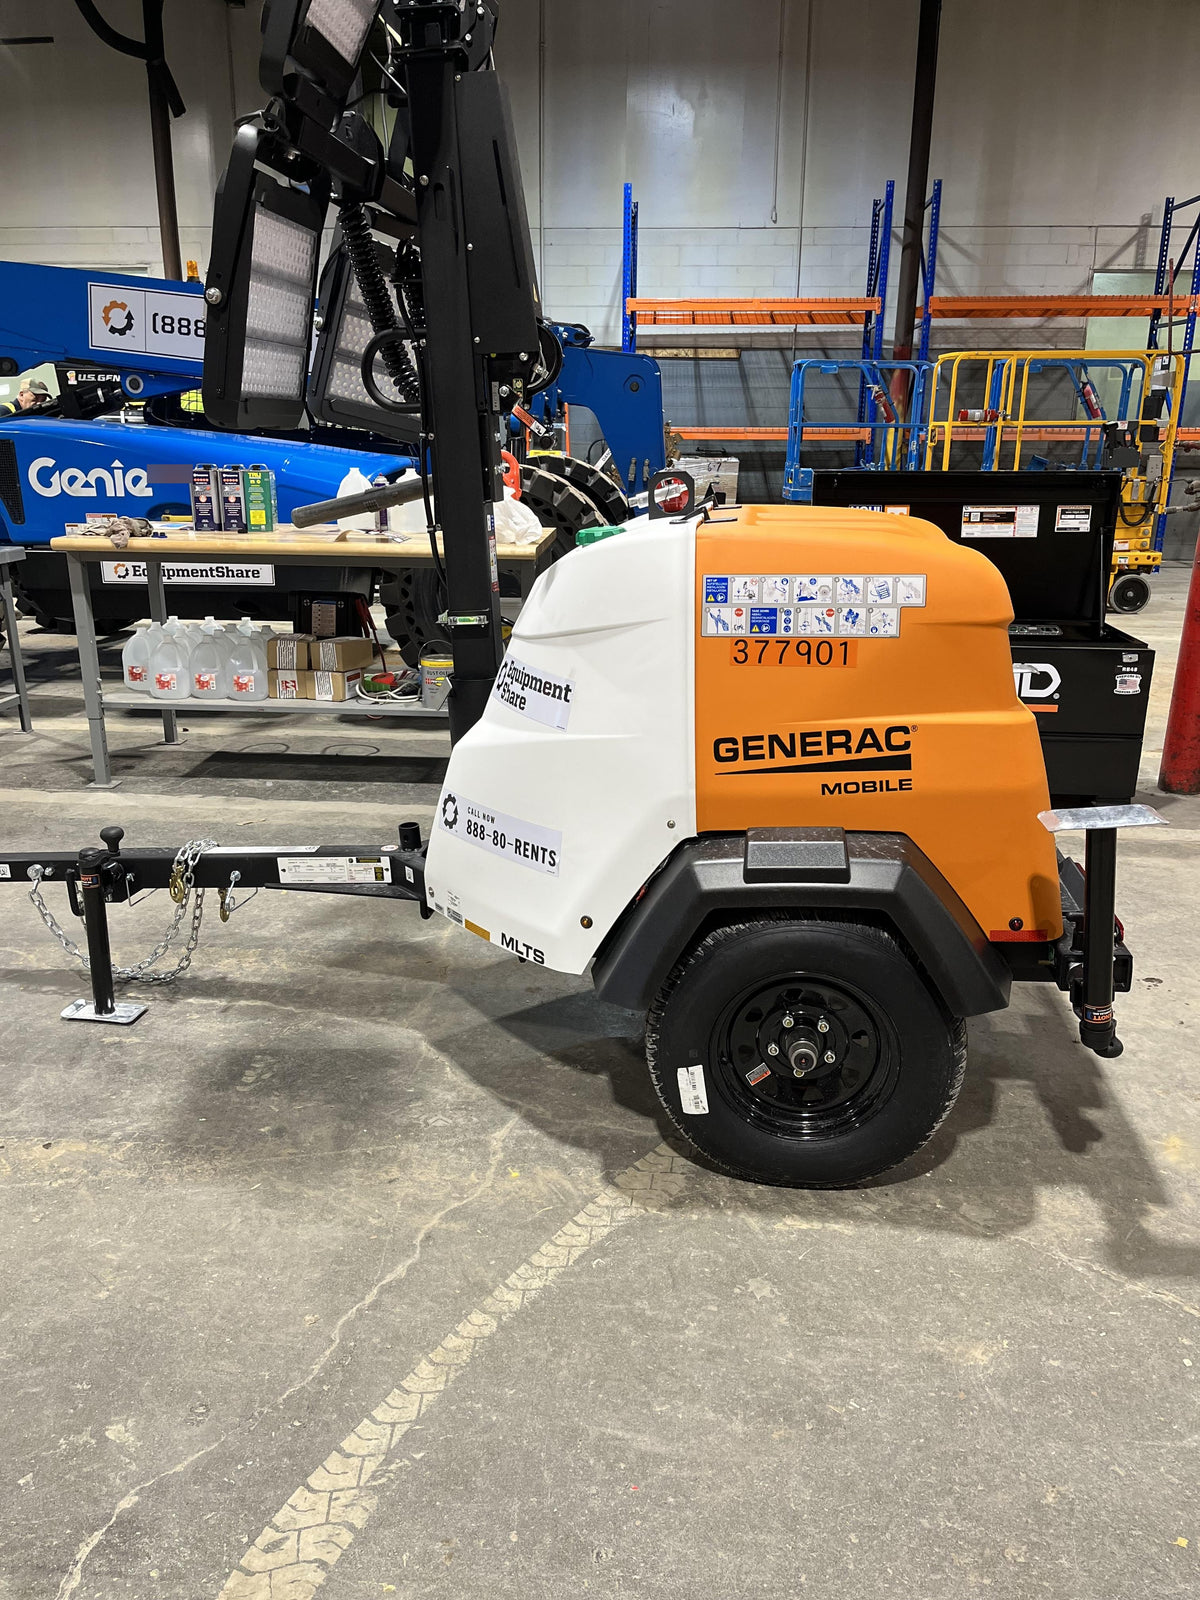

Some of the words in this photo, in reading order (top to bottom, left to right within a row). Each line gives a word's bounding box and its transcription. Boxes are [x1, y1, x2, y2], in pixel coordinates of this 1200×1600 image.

[28, 457, 153, 497] Genie
[131, 564, 260, 579] EipmentShare
[733, 639, 849, 665] 377901
[500, 681, 527, 711] Share
[507, 660, 572, 703] Equipment
[713, 725, 912, 763] GENERAC
[821, 778, 913, 795] MOBILE
[467, 806, 481, 819] CALL
[482, 811, 496, 824] NOW
[466, 818, 557, 868] 888-80-RENTS
[501, 932, 545, 965] MLTS
